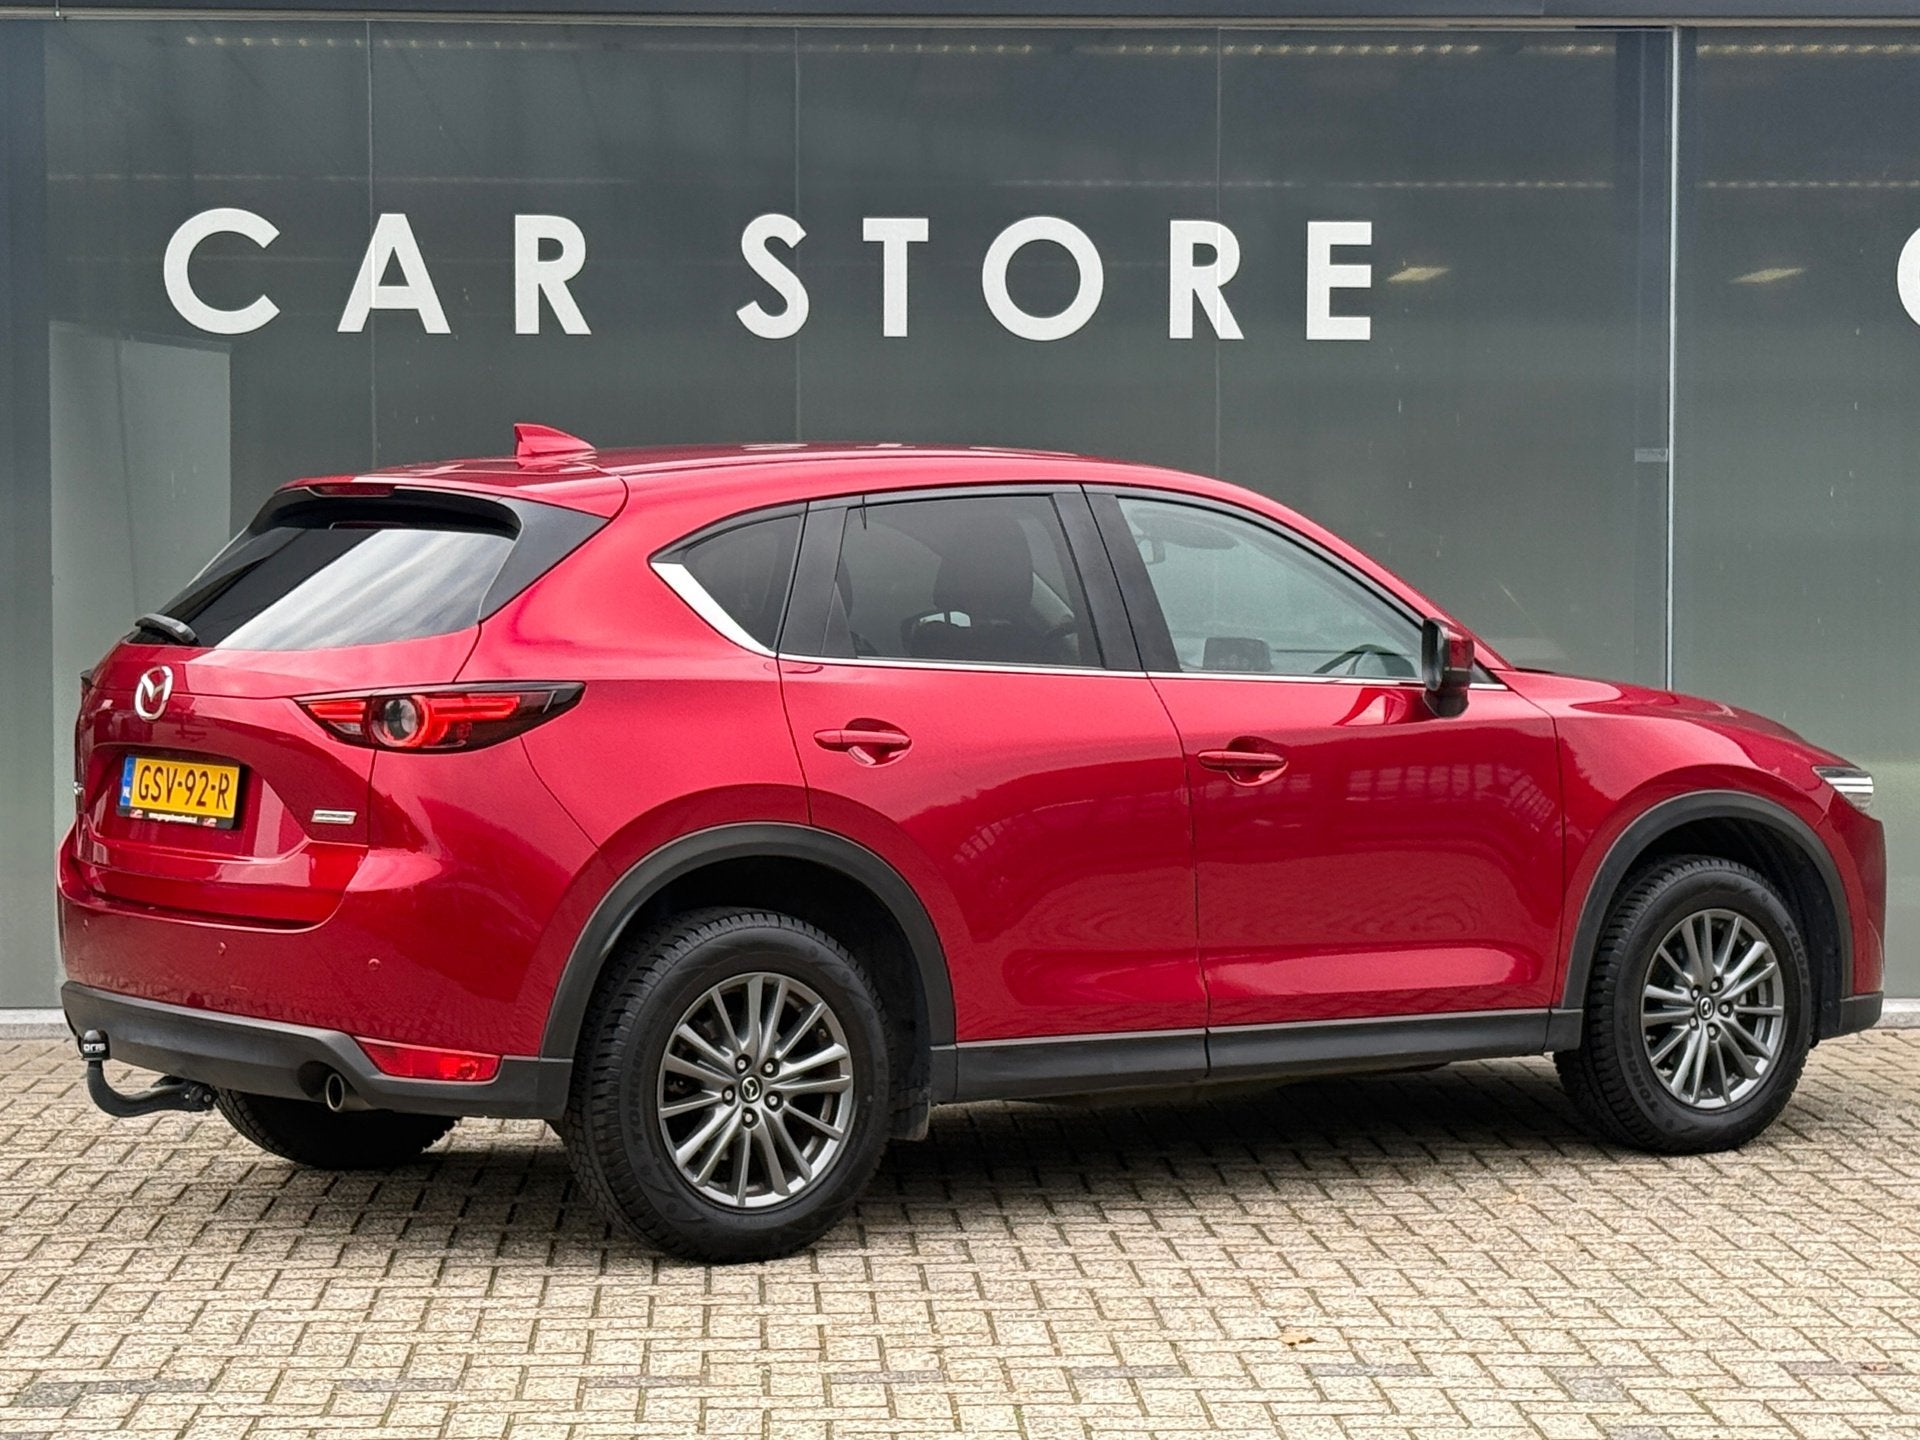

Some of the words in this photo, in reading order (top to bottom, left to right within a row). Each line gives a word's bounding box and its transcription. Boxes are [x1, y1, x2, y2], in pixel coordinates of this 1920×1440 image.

[164, 208, 591, 335] CAR
[737, 214, 1372, 340] STORE
[138, 765, 230, 811] GSV-92-R
